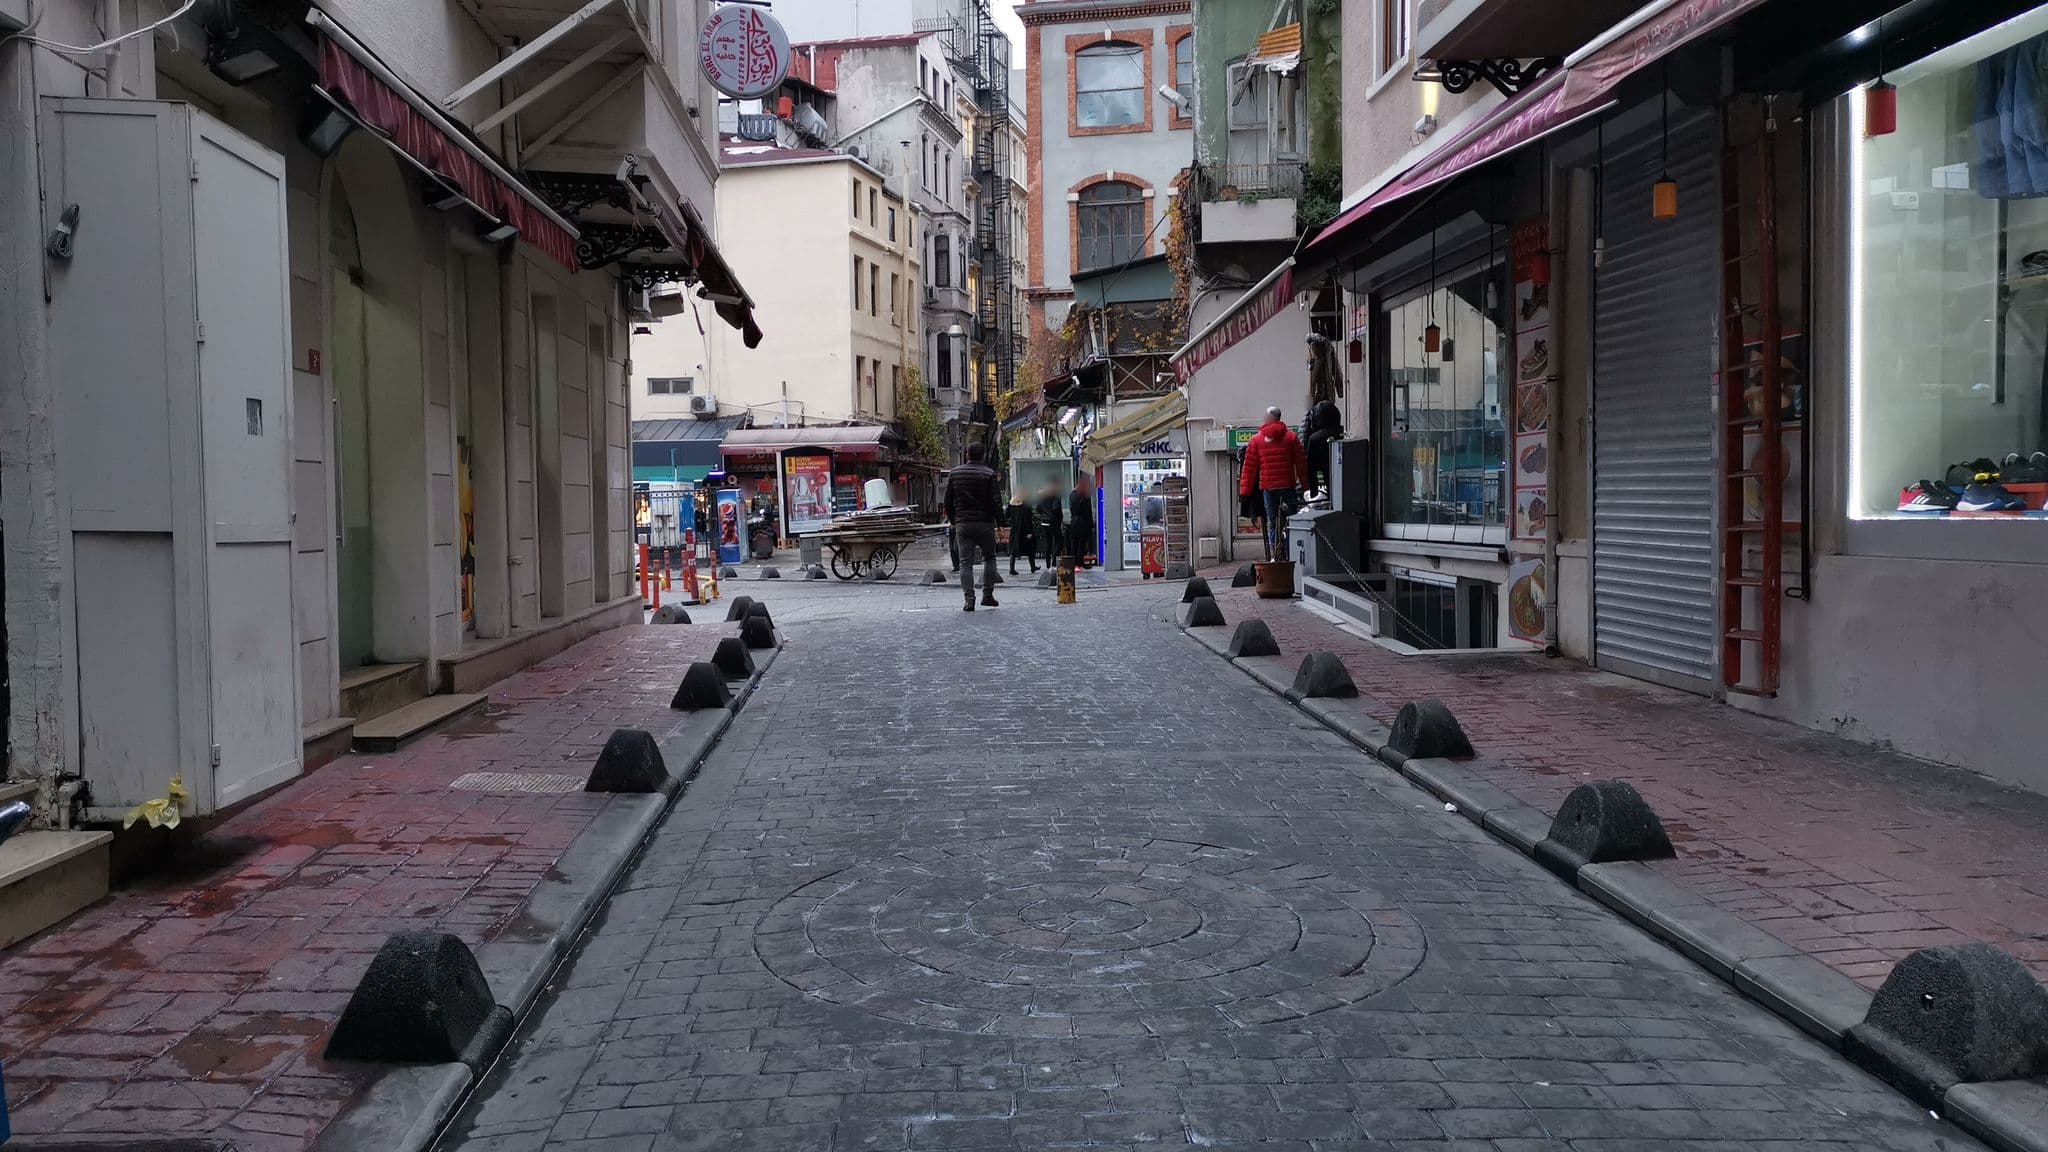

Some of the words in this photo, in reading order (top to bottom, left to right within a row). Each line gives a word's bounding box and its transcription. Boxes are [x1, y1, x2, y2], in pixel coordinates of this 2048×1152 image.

[703, 14, 723, 39] ARAB
[701, 41, 710, 52] EL
[737, 44, 746, 92] RESTORAN
